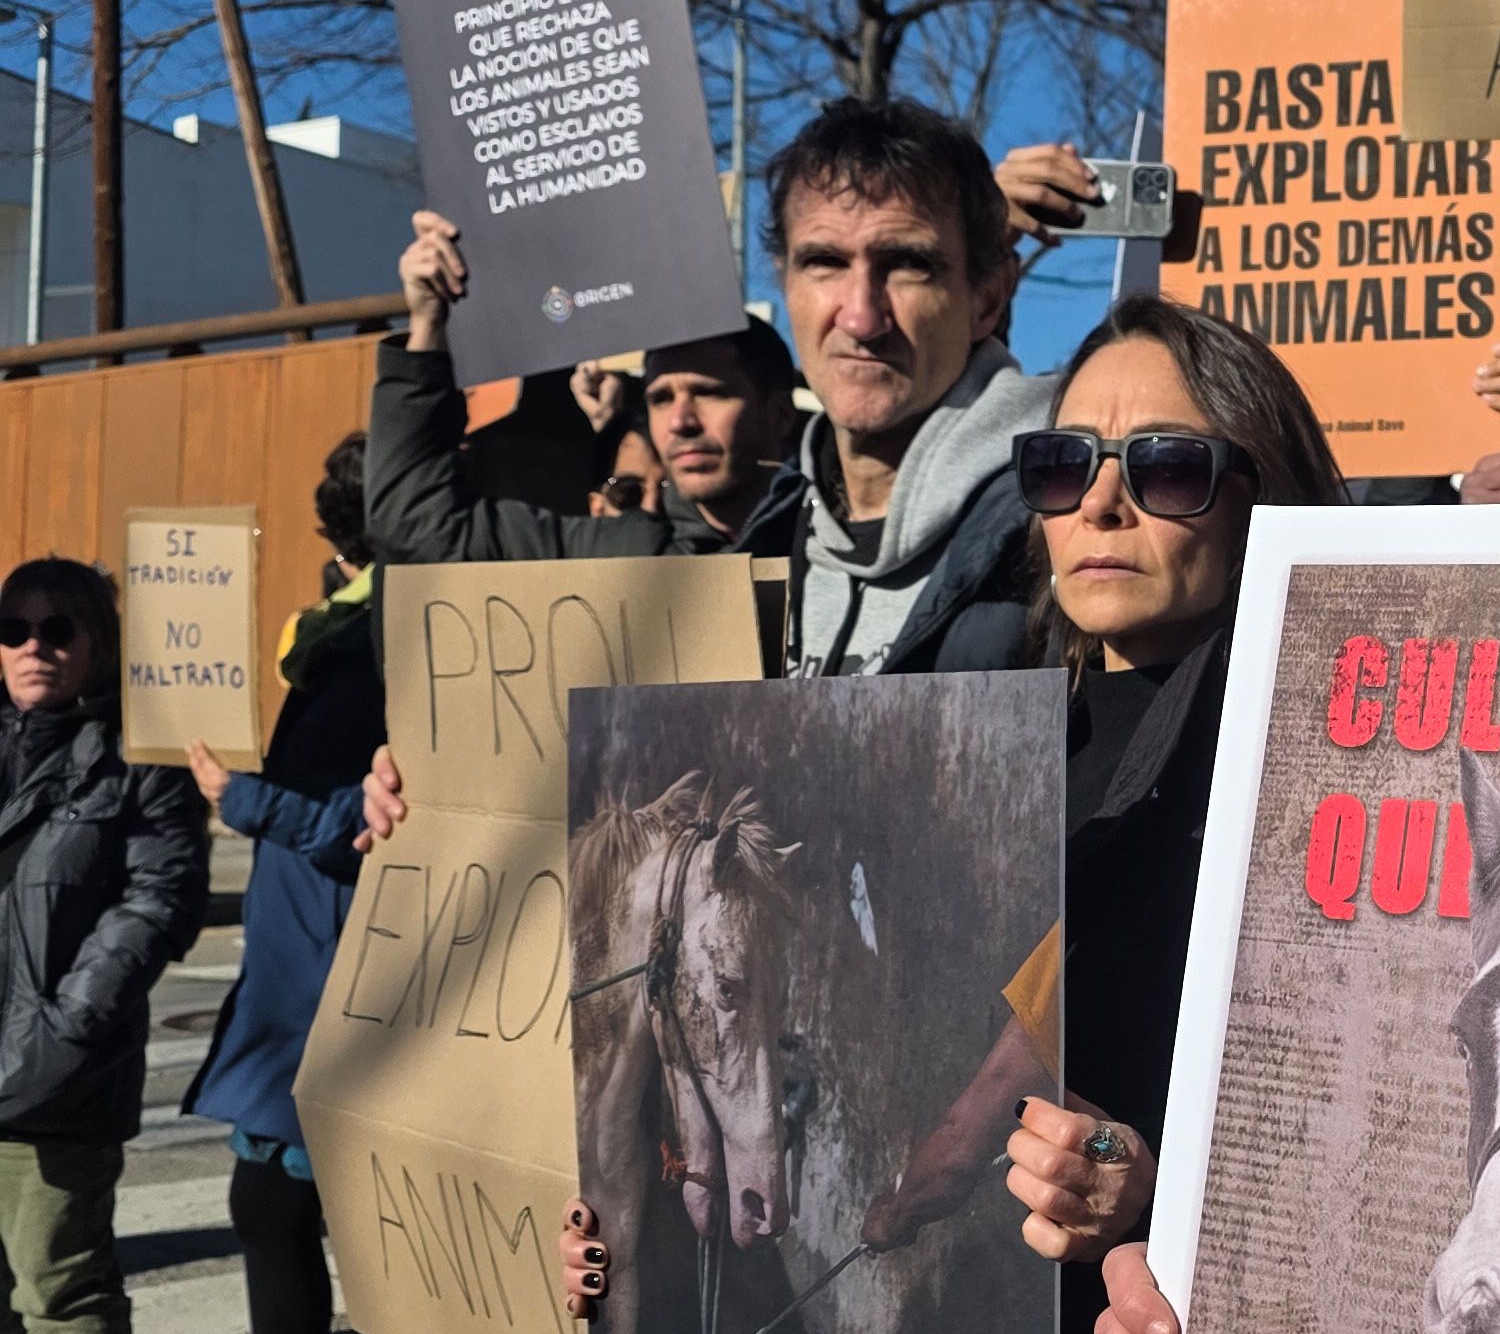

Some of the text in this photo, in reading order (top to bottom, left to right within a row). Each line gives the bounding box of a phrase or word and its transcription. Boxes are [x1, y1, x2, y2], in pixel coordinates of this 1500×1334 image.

[449, 17, 642, 90] LA NOCIÓN DE QUE
[468, 0, 613, 58] QUE RECHAZA
[450, 44, 651, 117] LOS ANIMALES SEAN
[466, 75, 641, 138] VISTOS Y USADOS
[1205, 59, 1395, 135] BASTA
[473, 102, 644, 163] COMO ESCLAVOS
[485, 130, 642, 188] AL SERVICIO DE
[488, 157, 648, 215] LA HUMANIDAD
[1201, 135, 1493, 208] EXPLOTAR
[1196, 202, 1495, 273] A LOS DEMÁS
[1202, 272, 1496, 346] ANIMALES
[166, 529, 197, 558] SI
[166, 620, 202, 651] NO
[129, 662, 246, 690] MALTRATO
[343, 863, 571, 1043] EXPLO
